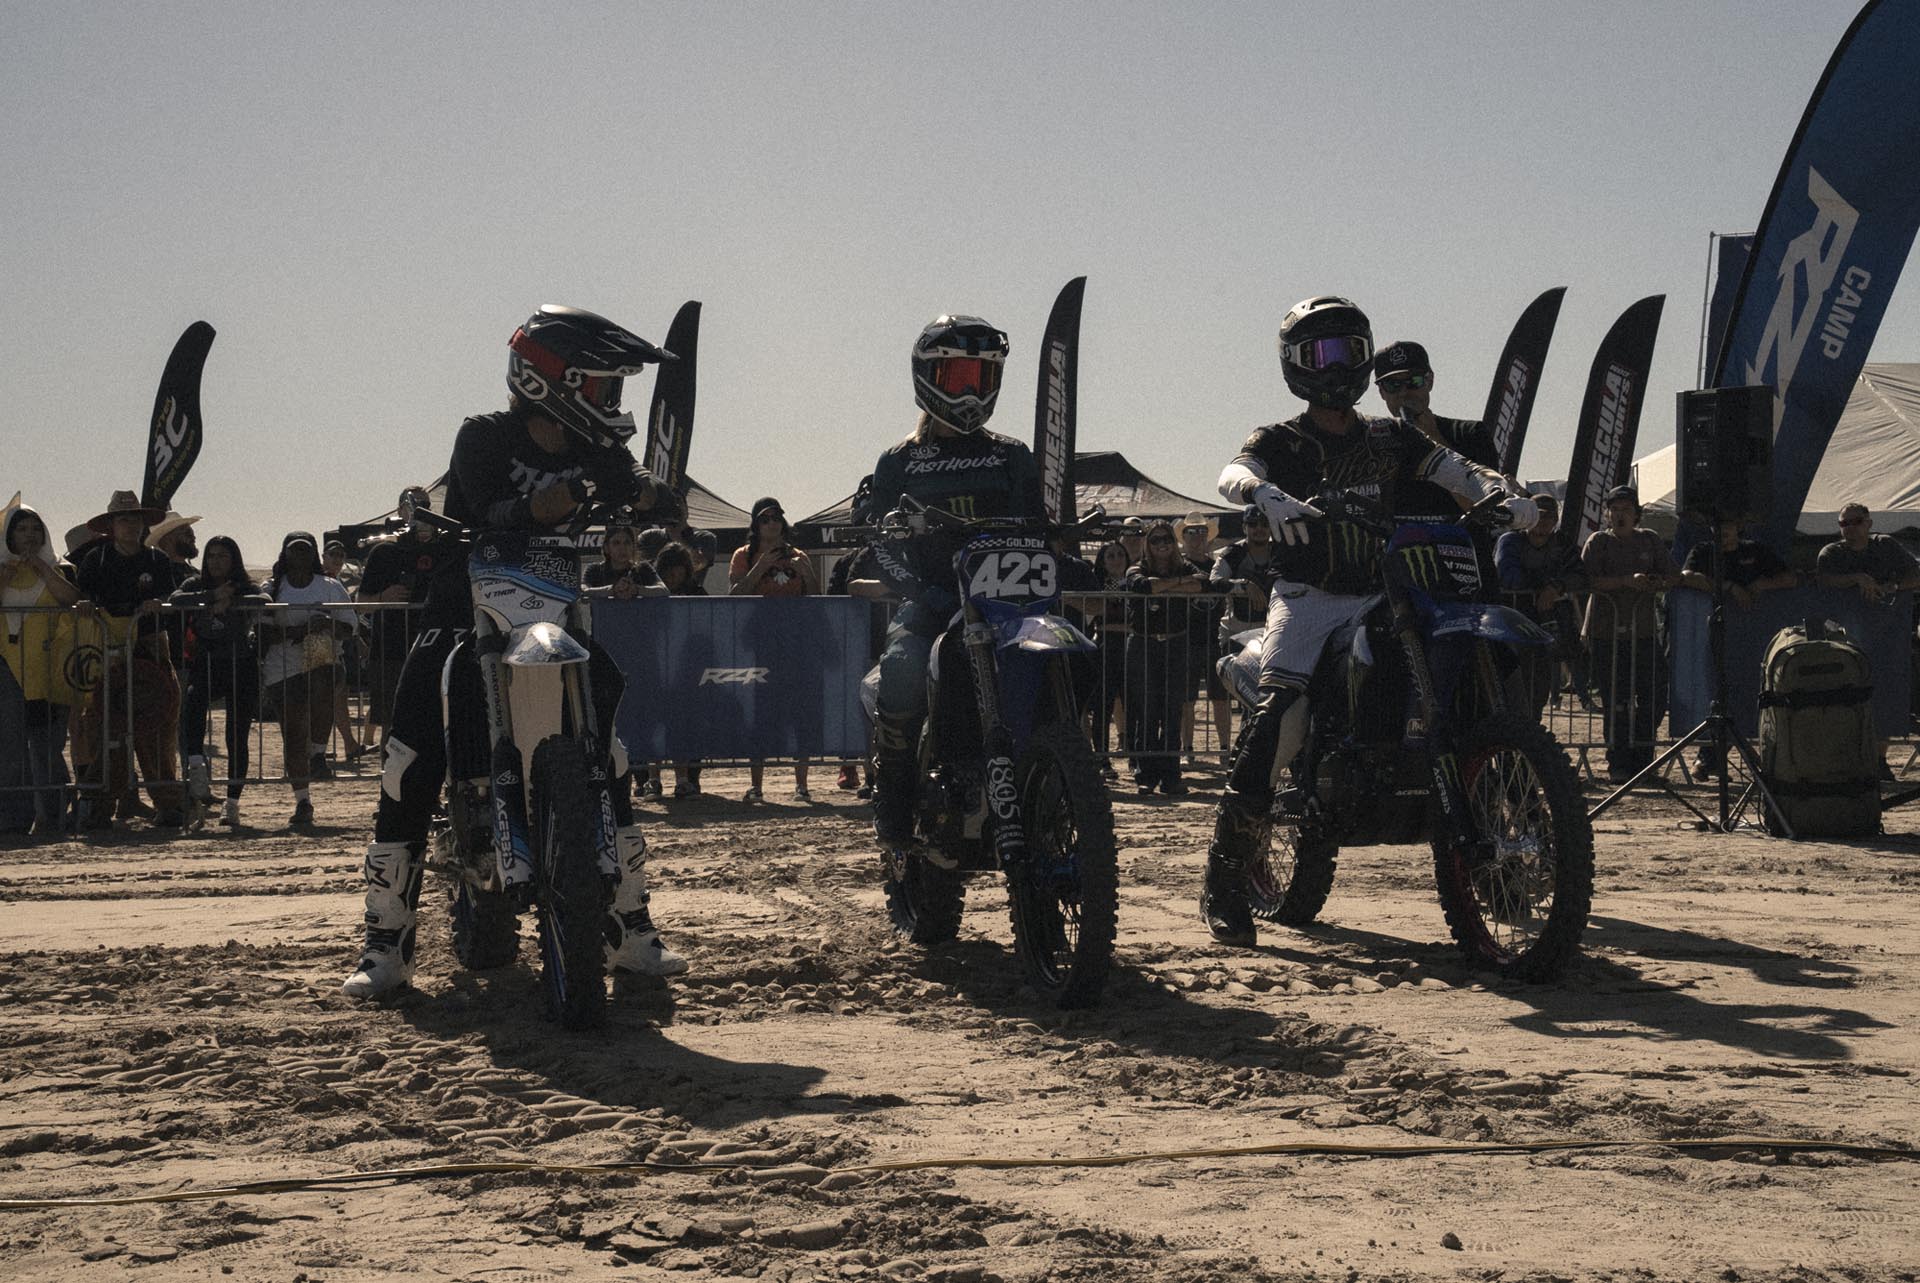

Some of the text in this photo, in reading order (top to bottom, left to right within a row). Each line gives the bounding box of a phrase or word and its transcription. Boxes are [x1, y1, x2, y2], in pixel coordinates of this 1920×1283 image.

[1818, 264, 1872, 360] CAMP
[1493, 364, 1523, 454] CULA
[904, 454, 1007, 475] FASTHOUSE
[1576, 369, 1623, 547] TEMECULA
[969, 551, 1057, 599] 423
[1006, 537, 1046, 549] GOLDEN
[699, 666, 771, 687] RZR
[600, 788, 618, 863] ACERBIS
[991, 767, 1021, 820] 805
[495, 796, 514, 871] ACERBIS
